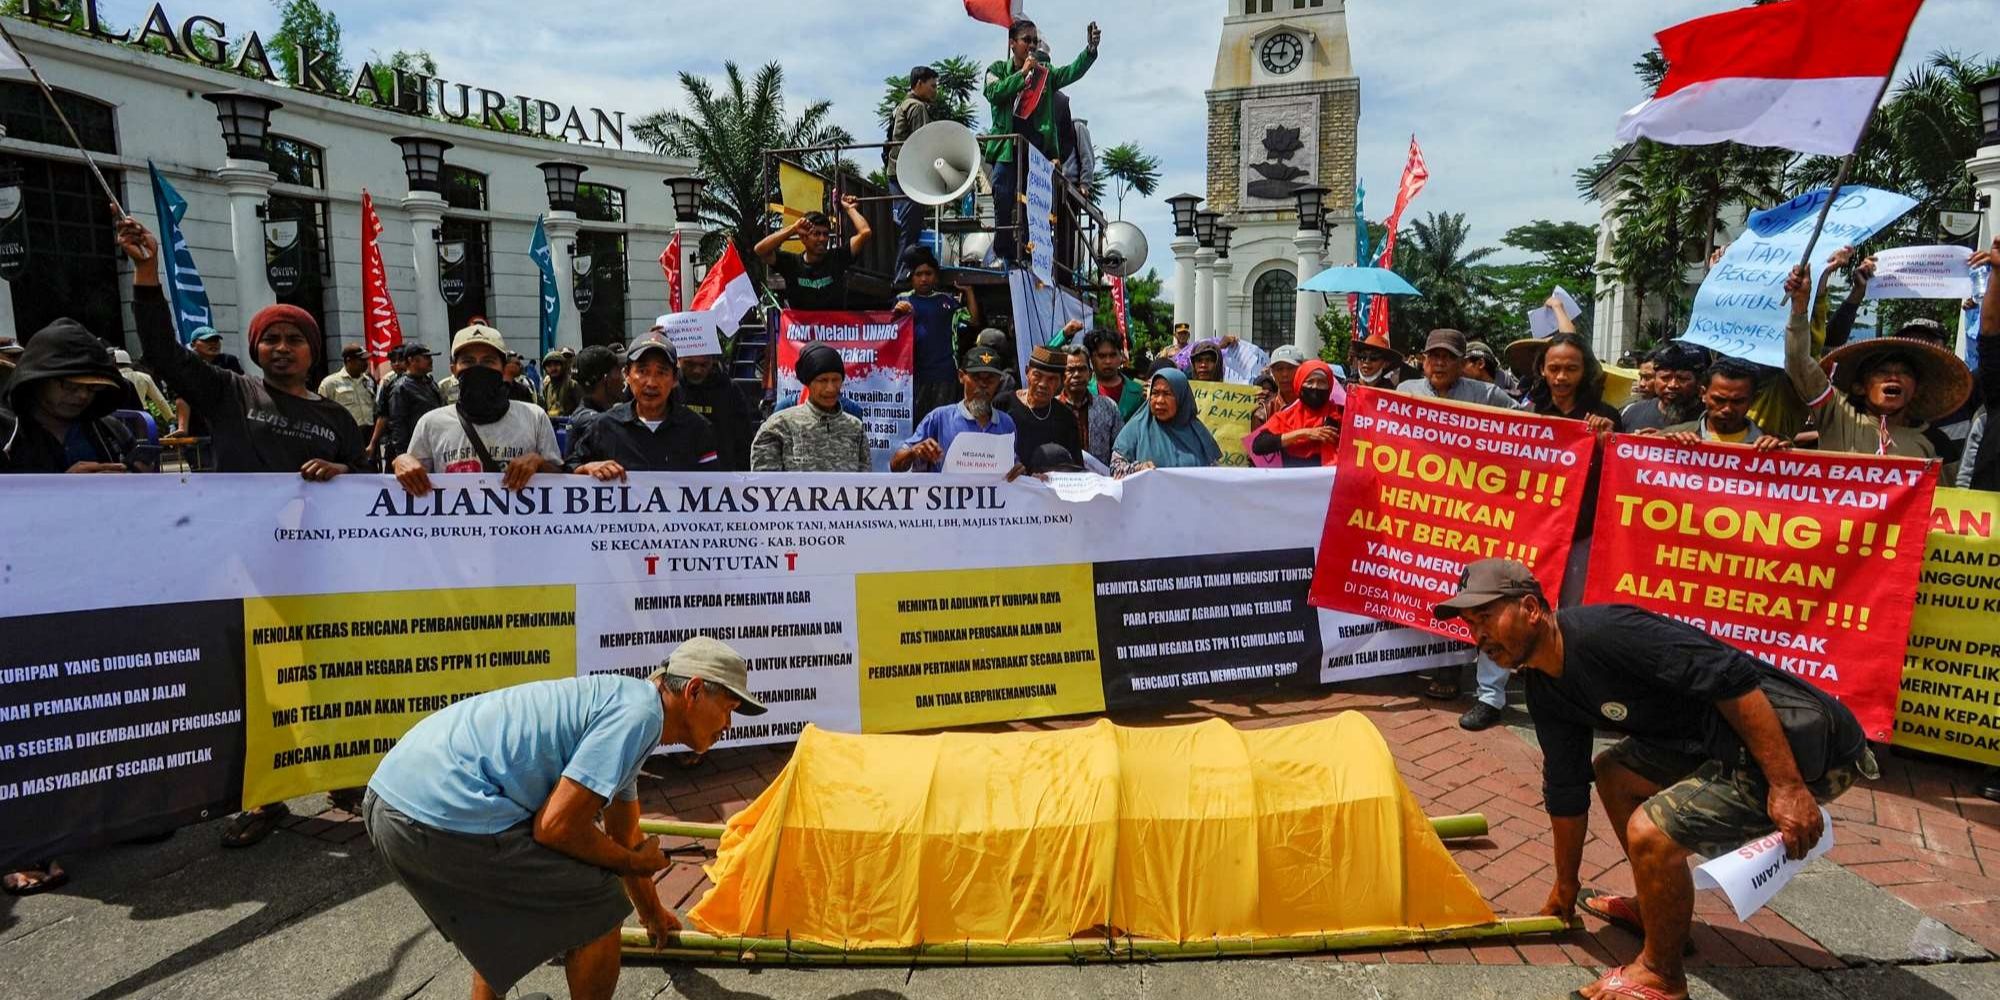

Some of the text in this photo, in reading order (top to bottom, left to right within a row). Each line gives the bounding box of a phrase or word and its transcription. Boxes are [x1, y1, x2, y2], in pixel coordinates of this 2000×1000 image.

[295, 43, 626, 150] KAHURIPAN
[1748, 241, 1792, 264] TAPI
[1715, 263, 1785, 286] BEKERJ
[1715, 294, 1777, 311] UNTUK
[814, 324, 859, 341] Melalui
[863, 324, 899, 340] UNHRC
[849, 390, 904, 404] kewajiban di
[246, 408, 336, 442] LEVIS JEANS
[874, 407, 910, 419] manusia
[1208, 405, 1251, 421] RAKYA
[1376, 398, 1554, 441] PAK PRESIDEN KITA
[874, 423, 898, 434] asasi
[1353, 415, 1577, 466] BP PRABOWO SUBIANTO
[956, 461, 998, 469] MILIK RAKYAT
[962, 451, 985, 459] NEGARA
[1616, 443, 1922, 487] GUBERNUR JAWA BARAT
[1352, 439, 1567, 507] TOLONG !!!
[366, 485, 1006, 516] ALIANSI BELA MASYARAKAT SIPIL
[1636, 468, 1888, 511] KANG DEDI MULYADI
[1380, 485, 1515, 530] HENTIKAN
[274, 513, 1073, 542] (PETANI, PEDAGANG, BURUH, TOKOH AGAMA/PEMUDA, ADVOKAT, KELOMPOK TANI, MAHASISWA, WALHI, LBH, MAJLIS TAKLIM, DKM)
[1347, 508, 1500, 561] ALAT BERAT
[1615, 494, 1901, 561] TOLONG !!!
[1928, 507, 1991, 538] AN
[591, 535, 846, 551] SE KECAMATAN PARUNG BOGOR
[1366, 541, 1413, 564] YANG
[668, 554, 779, 572] TUNTUTAN
[1655, 543, 1836, 590] HENTIKAN
[1930, 548, 1984, 566] ALAM
[1096, 567, 1313, 596] MEMINTA SATGAS MAFIA TANAH MENGUSUT TUNTAS
[1919, 570, 2000, 590] NGGUN
[634, 591, 785, 611] MEMINTA KEPADA PEMERINTAH
[898, 593, 1039, 613] MEMINTA KURIPAN
[1148, 599, 1292, 625] PENJAHAT AGRARIA TERLIBAT
[1364, 601, 1416, 623] PARUNG
[1392, 591, 1423, 610] IWUL
[1614, 573, 1871, 632] ALAT BERAT !!!
[1931, 593, 1979, 610] HULU
[253, 614, 503, 646] MENOLAK KERAS RENCANA PEMBANGUNAN
[737, 622, 823, 640] LAHAN PERTANIAN
[923, 625, 1019, 643] TINDAKAN PERUSAKAN
[1710, 620, 1828, 655] MERUSAK
[1128, 632, 1286, 659] TANAH NEGARA CIMULANG
[1907, 634, 1962, 653] UPUN
[103, 647, 201, 672] DIDUGA DENGAN
[277, 649, 551, 685] DIATAS TANAH NEGARA CIMULANG
[755, 657, 788, 671] UNTUK
[789, 652, 853, 669] KEPENTINGAN
[868, 649, 1096, 680] PERUSAKAN PERTANIAN MASYARAKAT SECARA BRUTAL
[1354, 650, 1379, 665] TELAH
[1780, 655, 1839, 682] KITA
[1922, 657, 2000, 682] KONFLIK
[1131, 663, 1274, 692] MENCABUT SERTA MEMBATALKAN
[34, 683, 186, 718] PEMAKAMAN JALAN
[301, 702, 342, 723] TELAH
[408, 693, 448, 713] TERUS
[936, 691, 963, 706] TIDAK
[1901, 699, 1940, 719] DAN
[18, 708, 242, 757] SEGERA DIKEMBALIKAN PENGUASAAN
[1902, 721, 1940, 739] DAN
[1944, 730, 2000, 751] SIDAK
[273, 744, 332, 770] BENCANA
[22, 747, 213, 797] MASYARAKAT SECARA MUTLAK
[1751, 860, 1780, 889] KAMI
